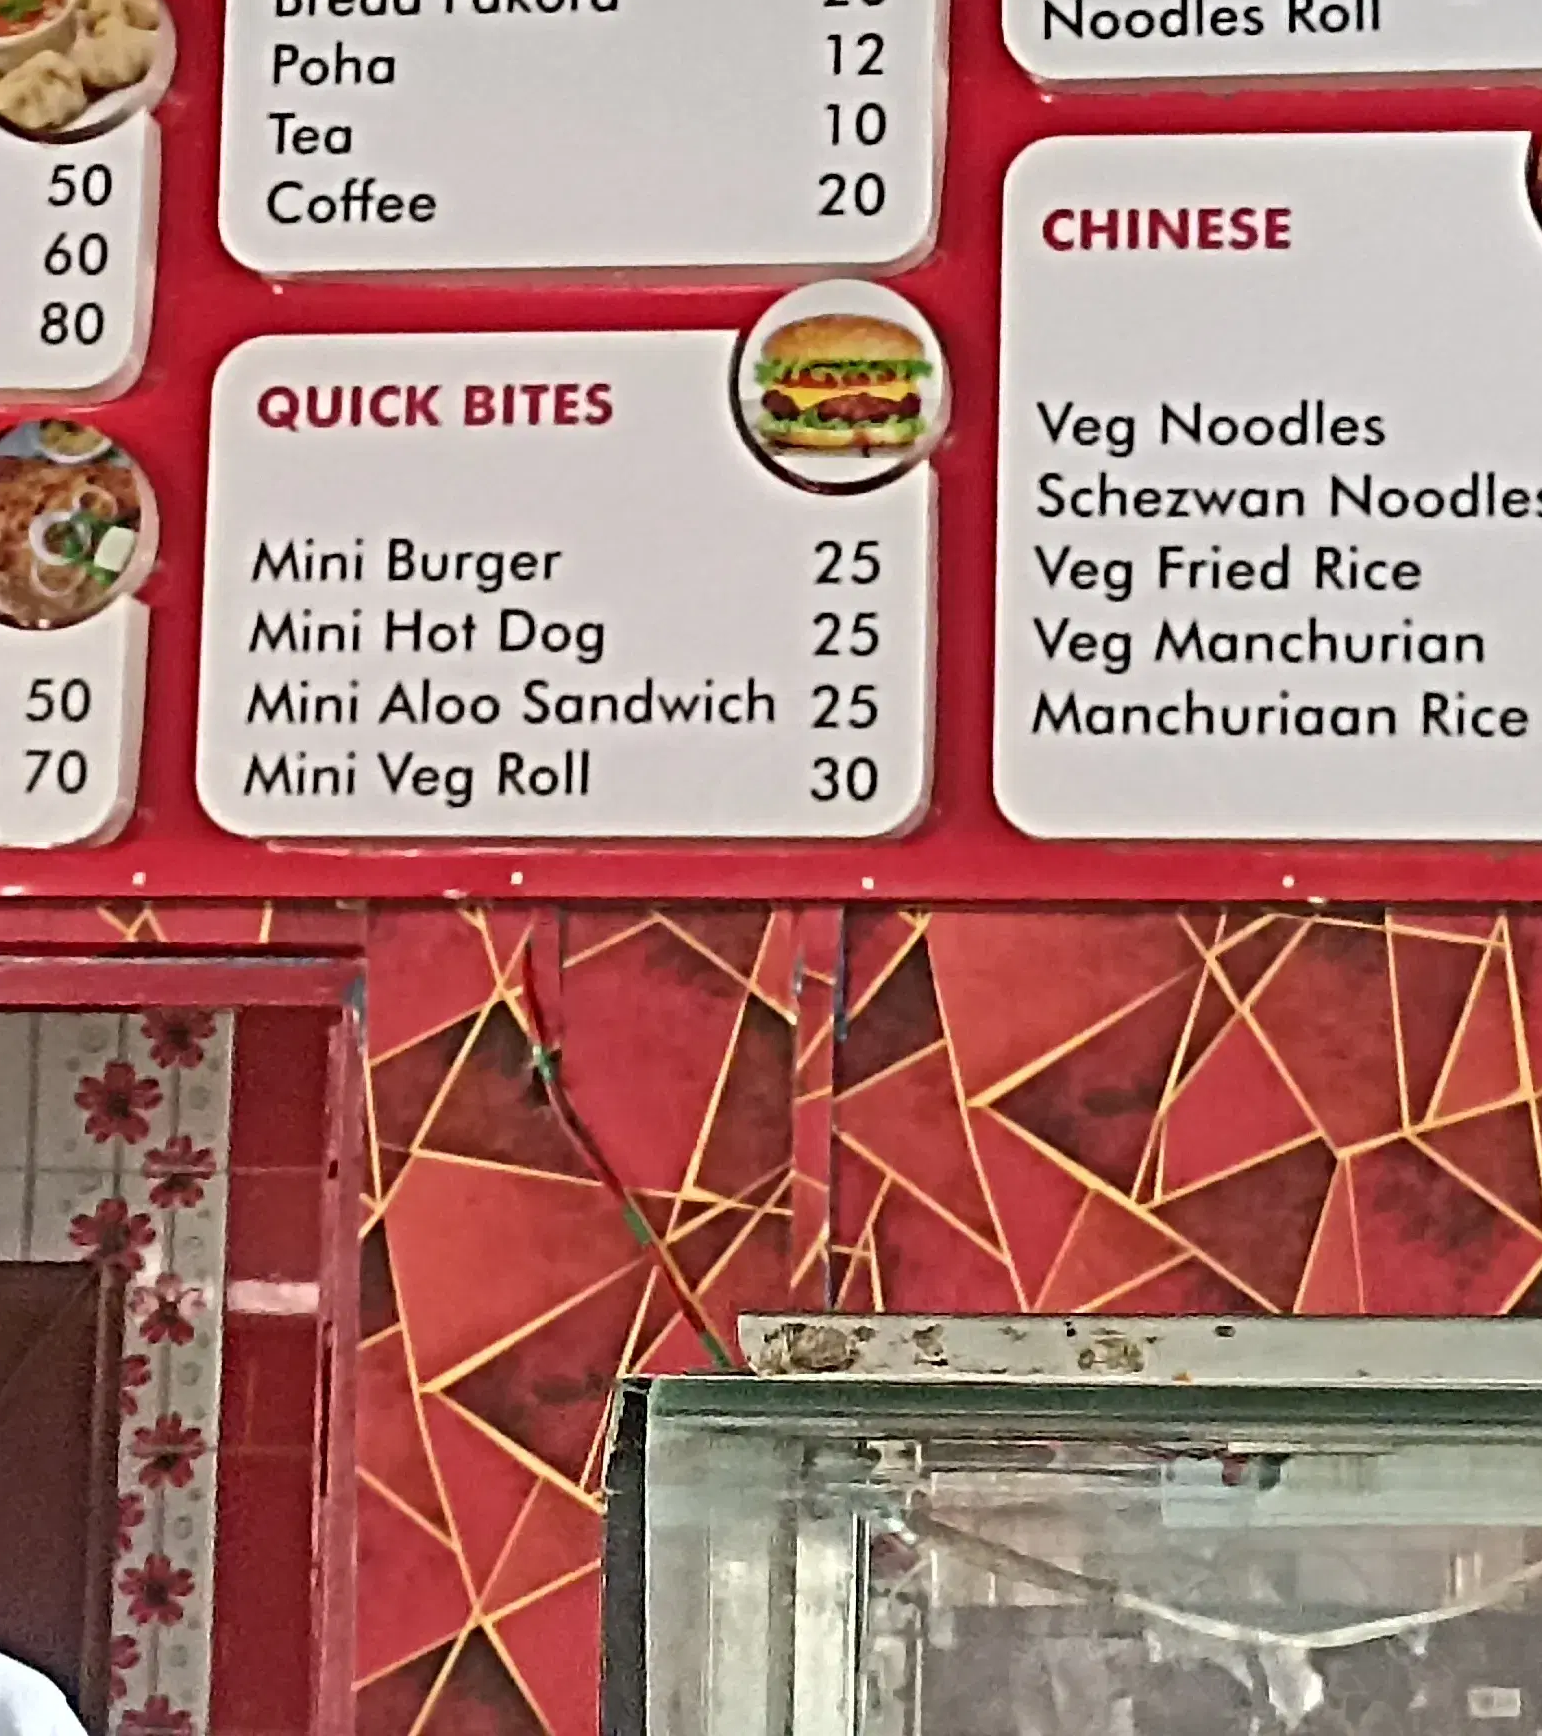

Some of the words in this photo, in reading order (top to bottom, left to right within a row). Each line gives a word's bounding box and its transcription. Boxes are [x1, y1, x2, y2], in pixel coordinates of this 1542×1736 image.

[273, 40, 396, 86] Poha
[827, 32, 885, 76] 12
[268, 112, 353, 156] Tea
[826, 102, 887, 146] 10
[47, 163, 113, 207] 50
[266, 177, 437, 225] Coffee
[818, 172, 886, 217] 20
[44, 232, 108, 276] 60
[1042, 207, 1292, 252] CHINESE
[40, 301, 105, 346] 80
[257, 384, 440, 433] QUICK
[463, 383, 613, 426] BITES
[1036, 401, 1136, 458] Veg
[1161, 399, 1386, 447] Noodles
[1037, 471, 1305, 518] Schezwan
[252, 537, 364, 582] Mini
[388, 537, 562, 594] Burger
[814, 540, 881, 585] 25
[1034, 545, 1133, 603] Veg
[1159, 543, 1290, 591] Fried
[1315, 545, 1422, 591] Rice
[248, 608, 362, 653] Mini
[385, 608, 476, 653] Hot
[499, 608, 605, 665] Dog
[813, 611, 879, 657] 25
[1033, 617, 1132, 675] Veg
[1154, 616, 1484, 664] Manchurian
[25, 678, 91, 723] 50
[247, 679, 359, 724] Mini
[378, 678, 501, 725] Aloo
[523, 676, 775, 725] Sandwich
[812, 684, 878, 730] 25
[1031, 688, 1397, 737] Manchuriaan
[1423, 691, 1529, 738] Rice
[25, 749, 88, 795] 70
[243, 750, 356, 797] Mini
[377, 751, 474, 809] Veg
[498, 749, 590, 797] Roll
[810, 756, 878, 802] 30
